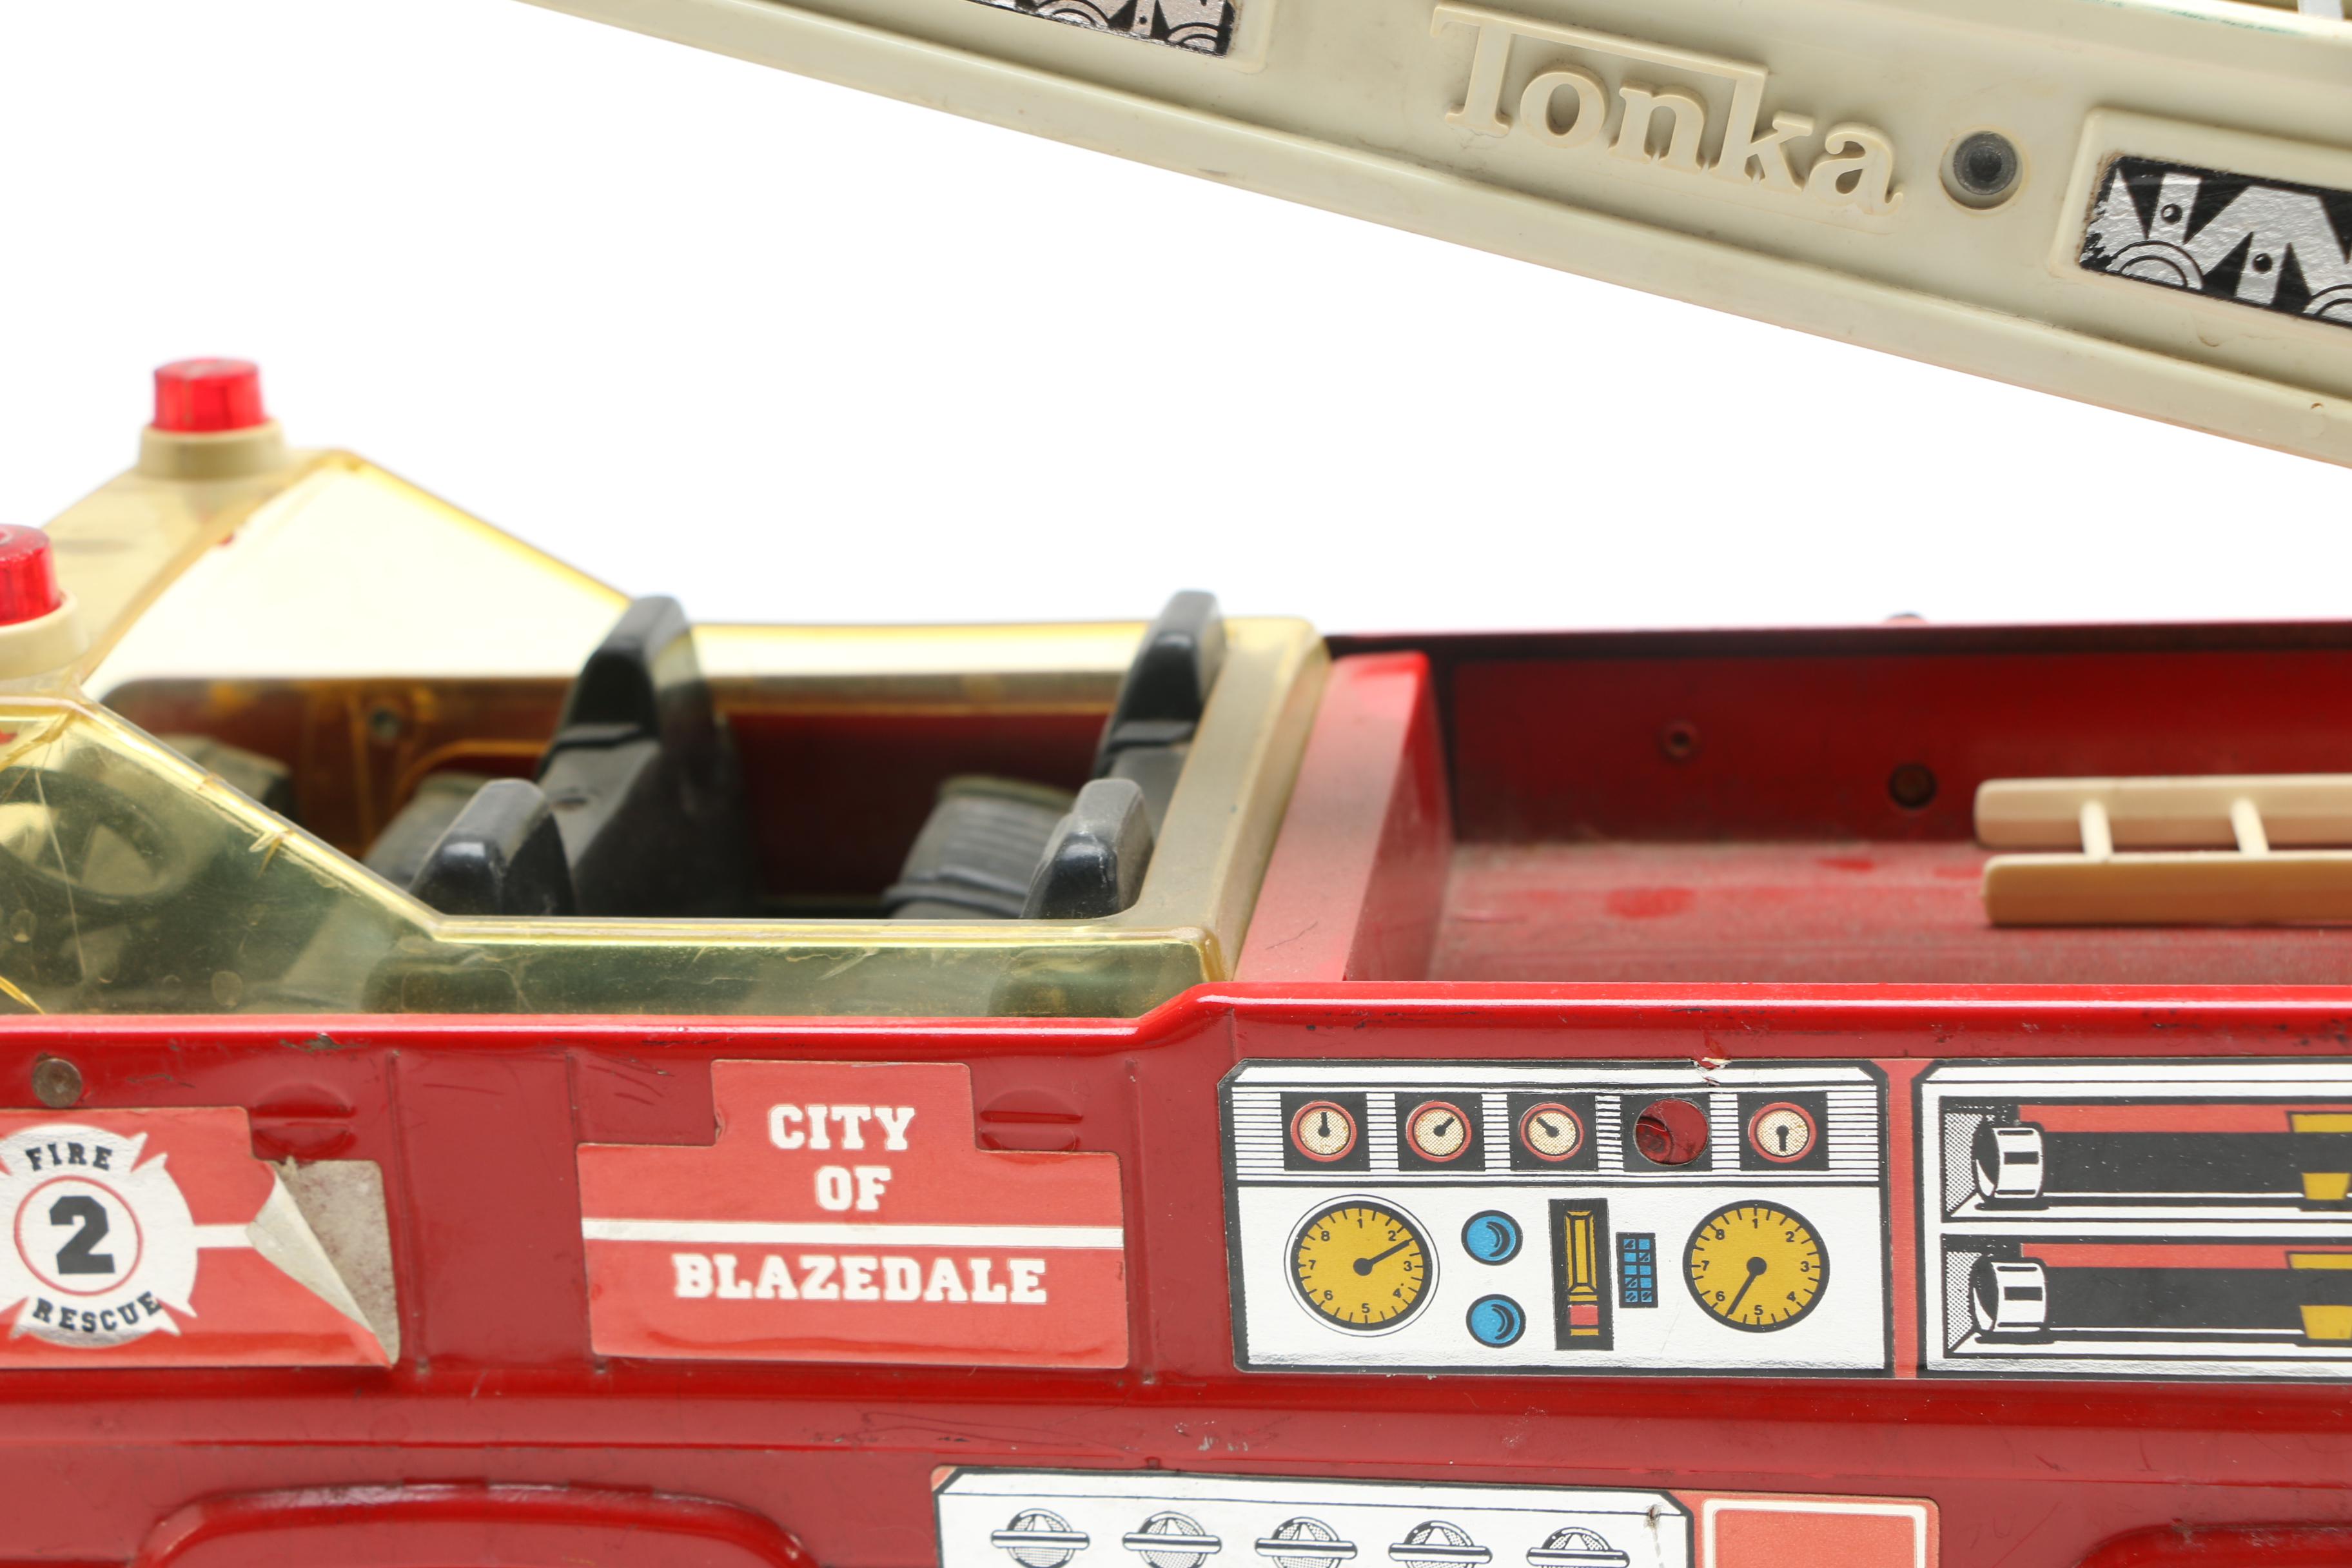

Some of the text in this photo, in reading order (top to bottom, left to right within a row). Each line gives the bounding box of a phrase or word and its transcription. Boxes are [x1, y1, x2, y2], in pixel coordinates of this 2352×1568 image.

[1430, 1, 1903, 215] Tonka
[768, 1104, 916, 1151] CITY
[25, 1142, 113, 1171] FIRE
[815, 1165, 892, 1211] OF
[1357, 1219, 1363, 1229] 1
[1752, 1218, 1758, 1229] 1
[49, 1195, 115, 1275] 2
[1320, 1230, 1330, 1242] 8
[1387, 1230, 1396, 1241] 2
[1715, 1229, 1725, 1240] 8
[1785, 1231, 1795, 1242] 2
[1308, 1259, 1317, 1270] 7
[1403, 1260, 1413, 1271] 3
[1701, 1260, 1710, 1271] 7
[1800, 1260, 1810, 1272] 3
[671, 1253, 1048, 1304] BLAZEDALE
[1323, 1289, 1333, 1300] 6
[1393, 1288, 1402, 1298] 4
[1715, 1291, 1725, 1302] 6
[1786, 1291, 1796, 1302] 4
[32, 1290, 161, 1334] RESCUE
[1361, 1303, 1370, 1313] 5
[1754, 1304, 1763, 1315] 5
